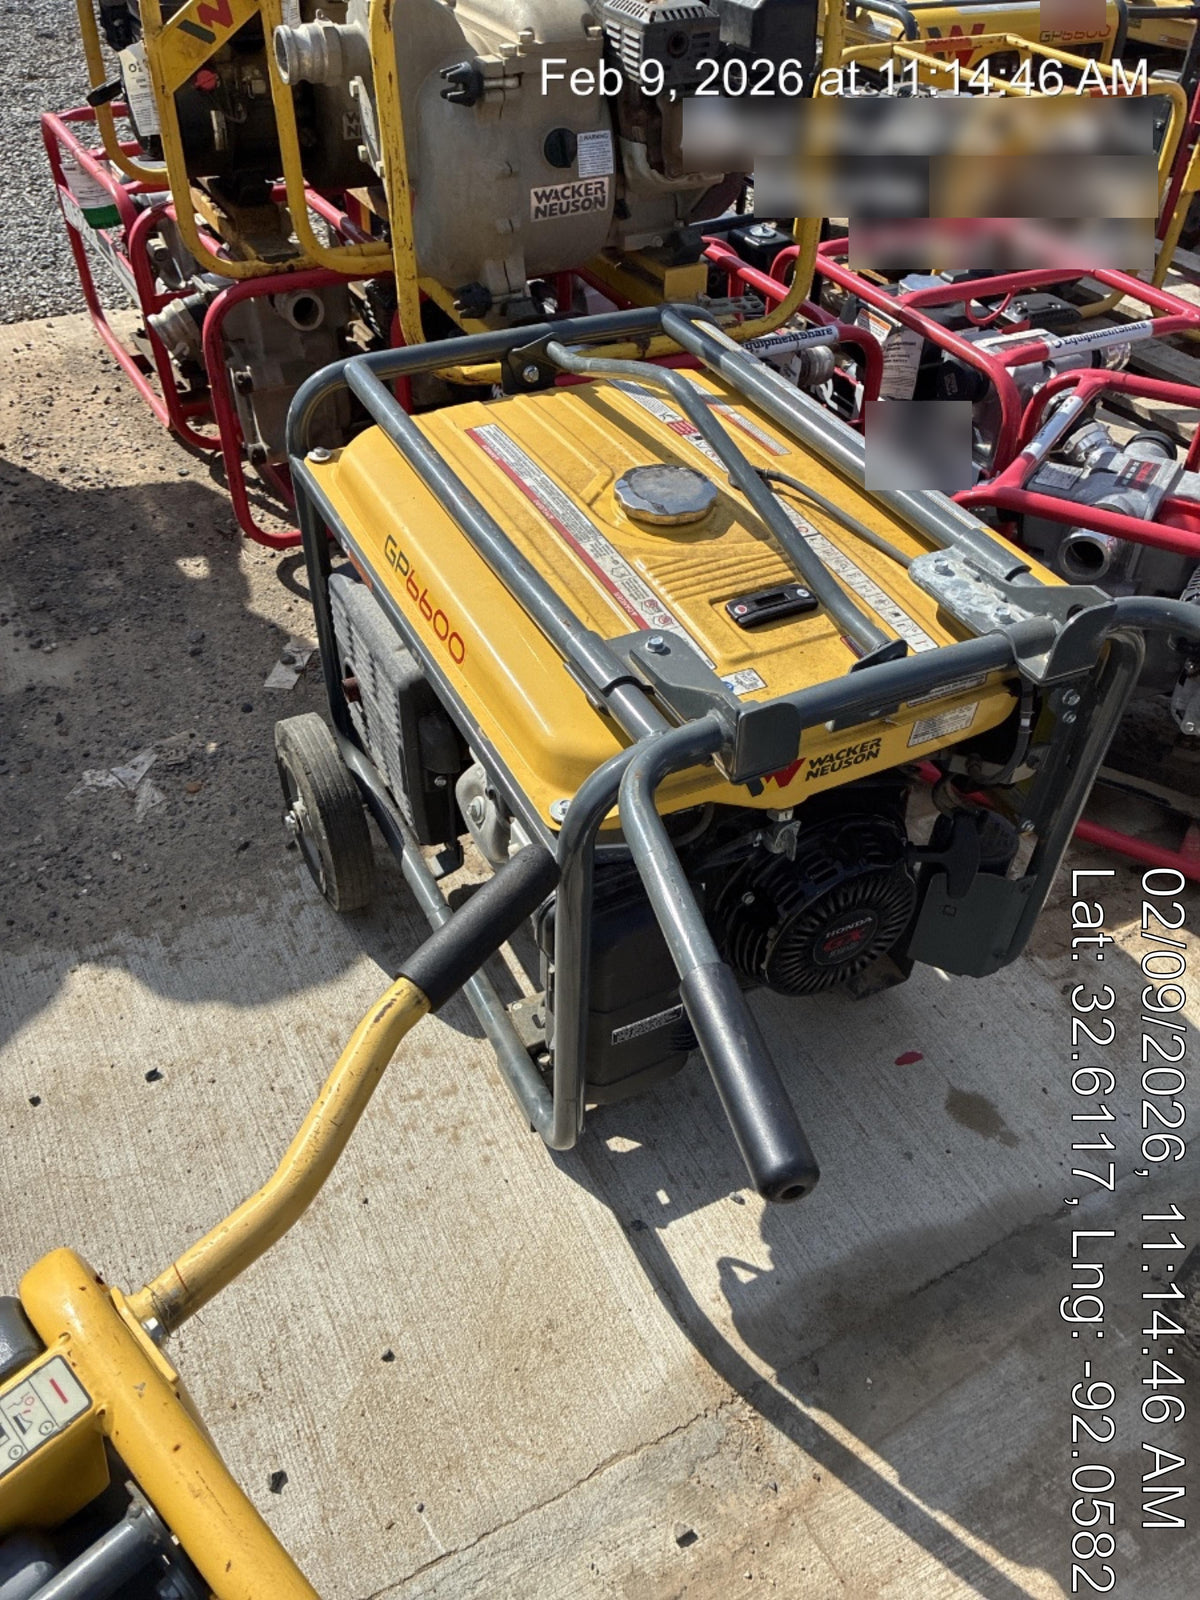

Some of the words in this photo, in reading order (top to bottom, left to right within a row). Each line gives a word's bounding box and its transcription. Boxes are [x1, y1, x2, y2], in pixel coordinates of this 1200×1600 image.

[533, 180, 607, 205] WACKER
[534, 194, 607, 220] NEUSON
[383, 533, 466, 665] GP6600
[804, 747, 881, 782] NEUSON
[808, 736, 882, 770] WACKER
[825, 916, 873, 939] HONDA
